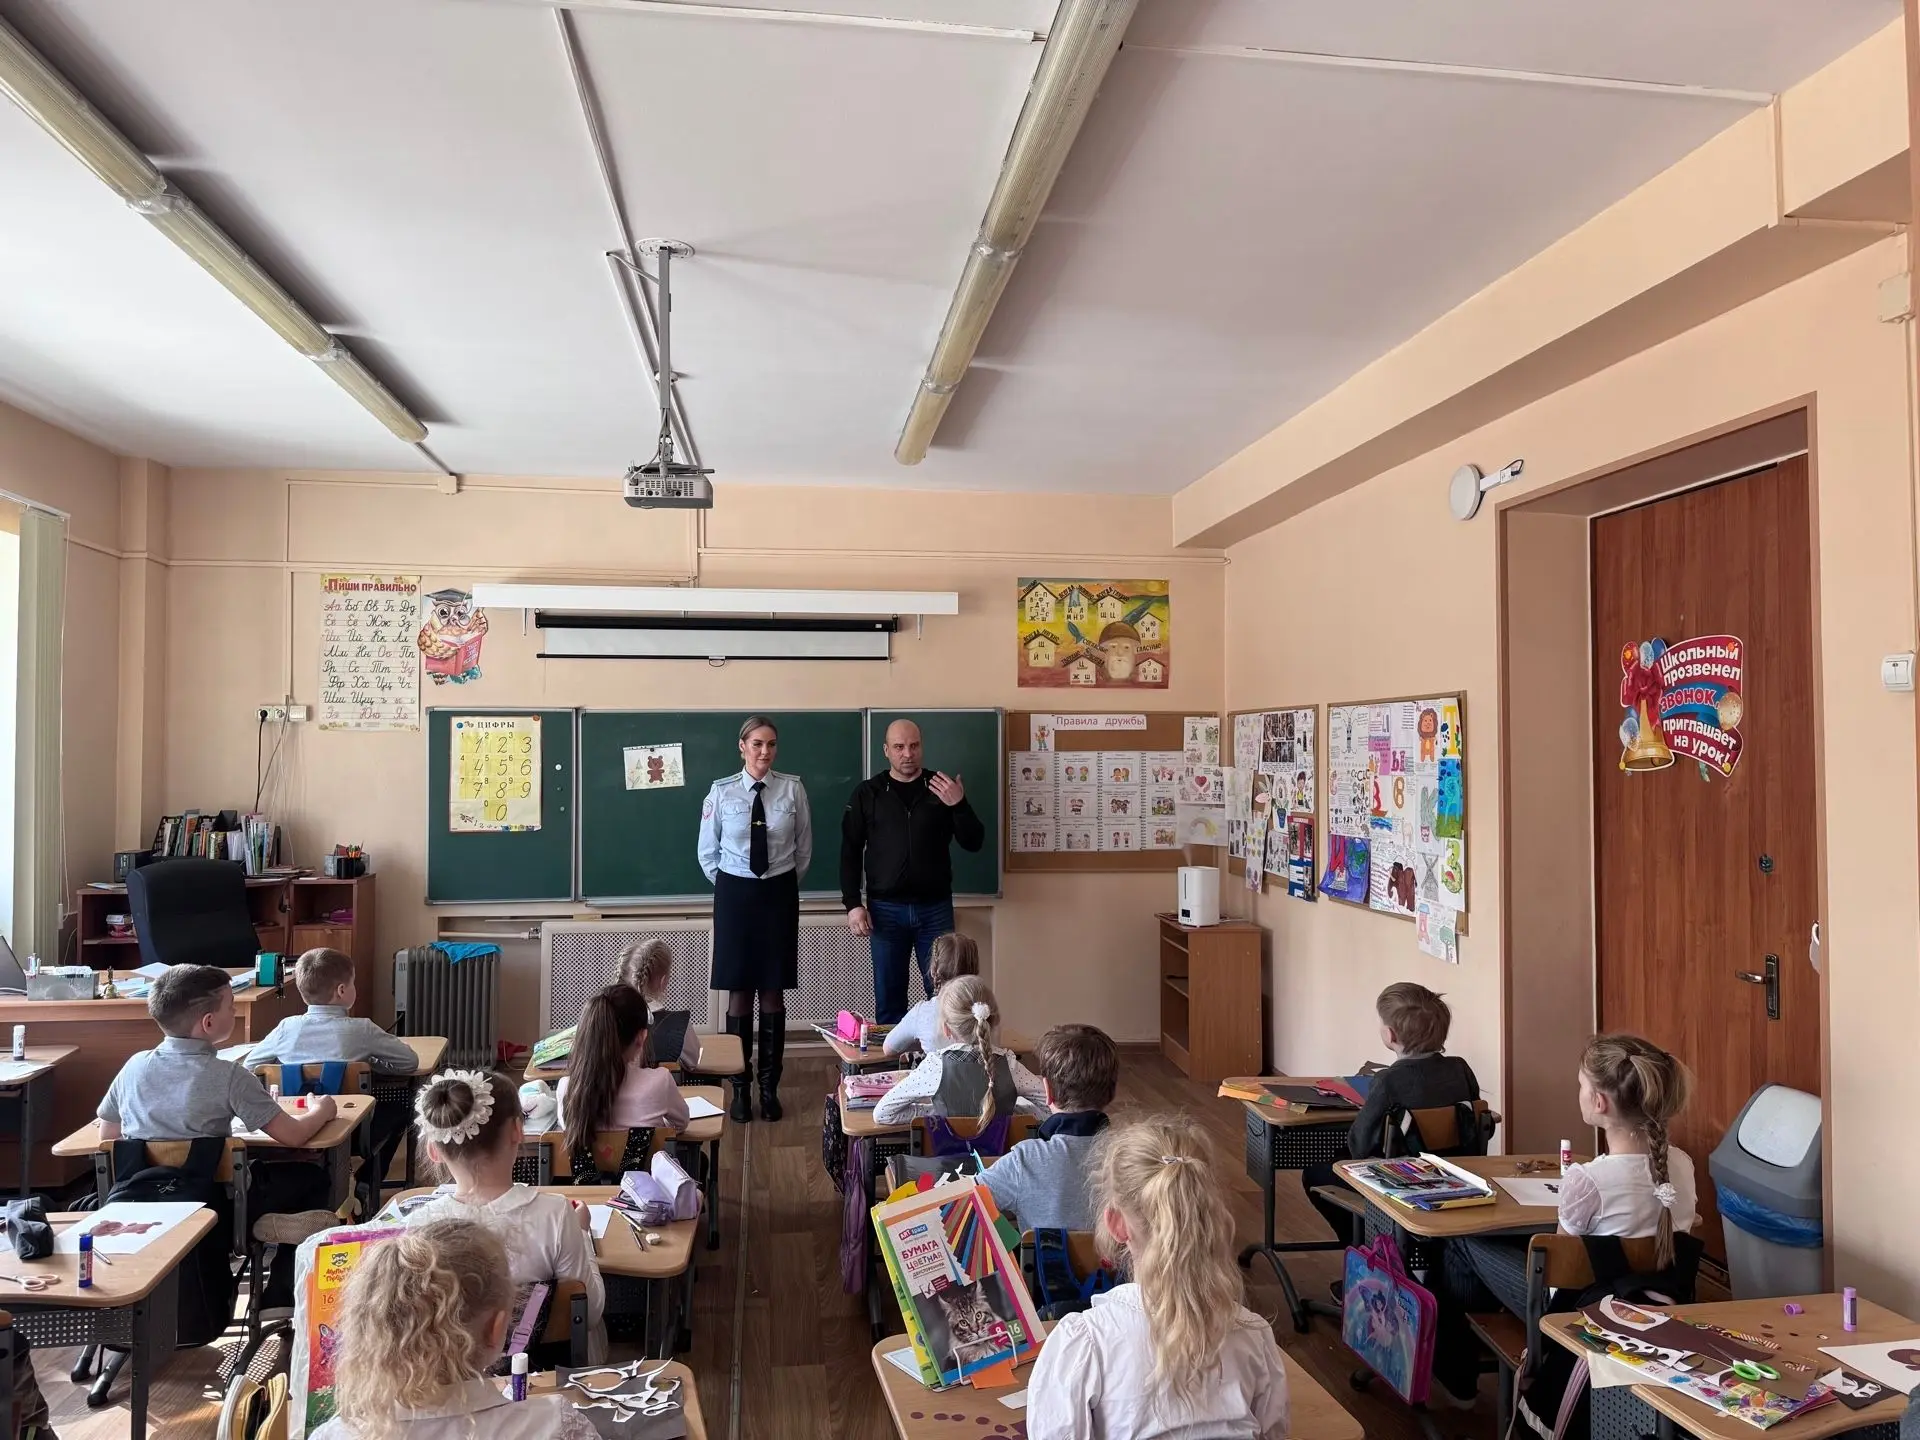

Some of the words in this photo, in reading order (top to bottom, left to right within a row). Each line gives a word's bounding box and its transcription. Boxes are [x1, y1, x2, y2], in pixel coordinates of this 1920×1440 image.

[361, 583, 417, 592] ПРАВИЛЬНО
[344, 598, 362, 612] Бб
[363, 599, 379, 612] Вв
[365, 614, 392, 627] Жж
[1660, 641, 1739, 674] Школьный
[1663, 662, 1741, 687] прозвенел
[477, 721, 515, 729] ЦИФРЫ
[1056, 716, 1098, 727] Правила
[1105, 716, 1145, 727] дружбы
[1662, 717, 1737, 750] приглашает
[1674, 734, 1689, 748] на
[475, 736, 484, 753] 1
[497, 736, 508, 753] 2
[521, 736, 532, 753] 3
[474, 759, 484, 776] 4
[497, 759, 508, 776] 5
[521, 759, 532, 776] 6
[473, 781, 483, 799] 7
[496, 781, 508, 799] 8
[521, 781, 532, 799] 9
[495, 804, 508, 821] 0
[901, 1240, 939, 1259] БУМАГА
[906, 1252, 943, 1270] ЦВЕТНАЯ
[322, 1294, 334, 1305] 16
[1008, 1322, 1021, 1336] 16
